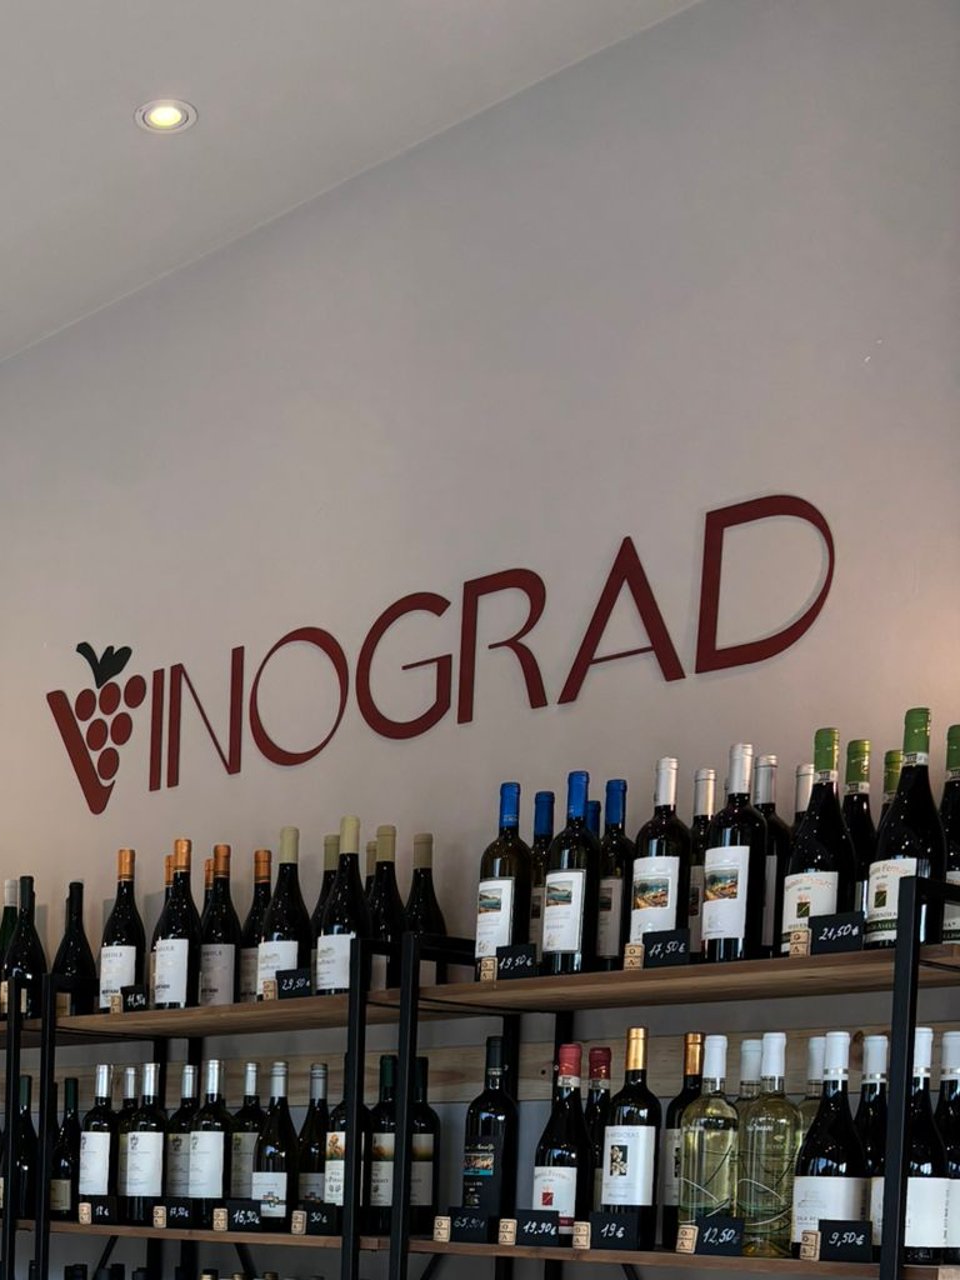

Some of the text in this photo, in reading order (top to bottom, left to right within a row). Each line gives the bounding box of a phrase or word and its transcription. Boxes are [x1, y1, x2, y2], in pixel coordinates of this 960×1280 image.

[46, 494, 836, 815] VINOGRAD
[600, 1223, 626, 1239] 19€
[828, 1231, 865, 1247] 9,50€
